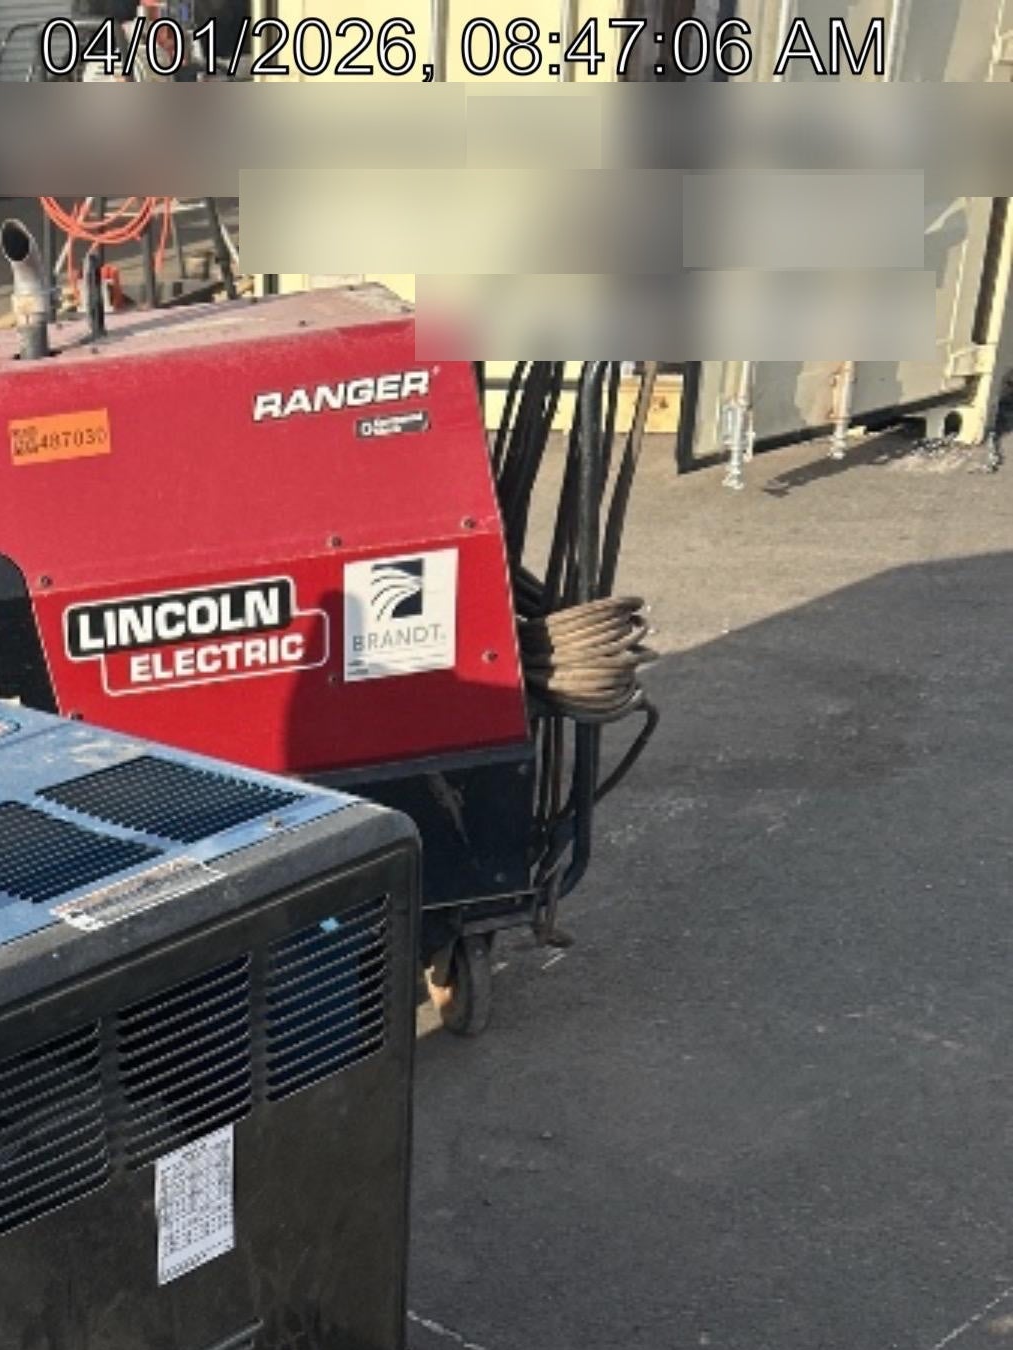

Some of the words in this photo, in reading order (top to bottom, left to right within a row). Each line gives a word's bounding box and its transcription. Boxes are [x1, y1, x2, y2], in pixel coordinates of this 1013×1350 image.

[252, 369, 430, 422] RANGER
[77, 586, 281, 652] LINCOLN
[129, 633, 305, 684] ELECTRIC
